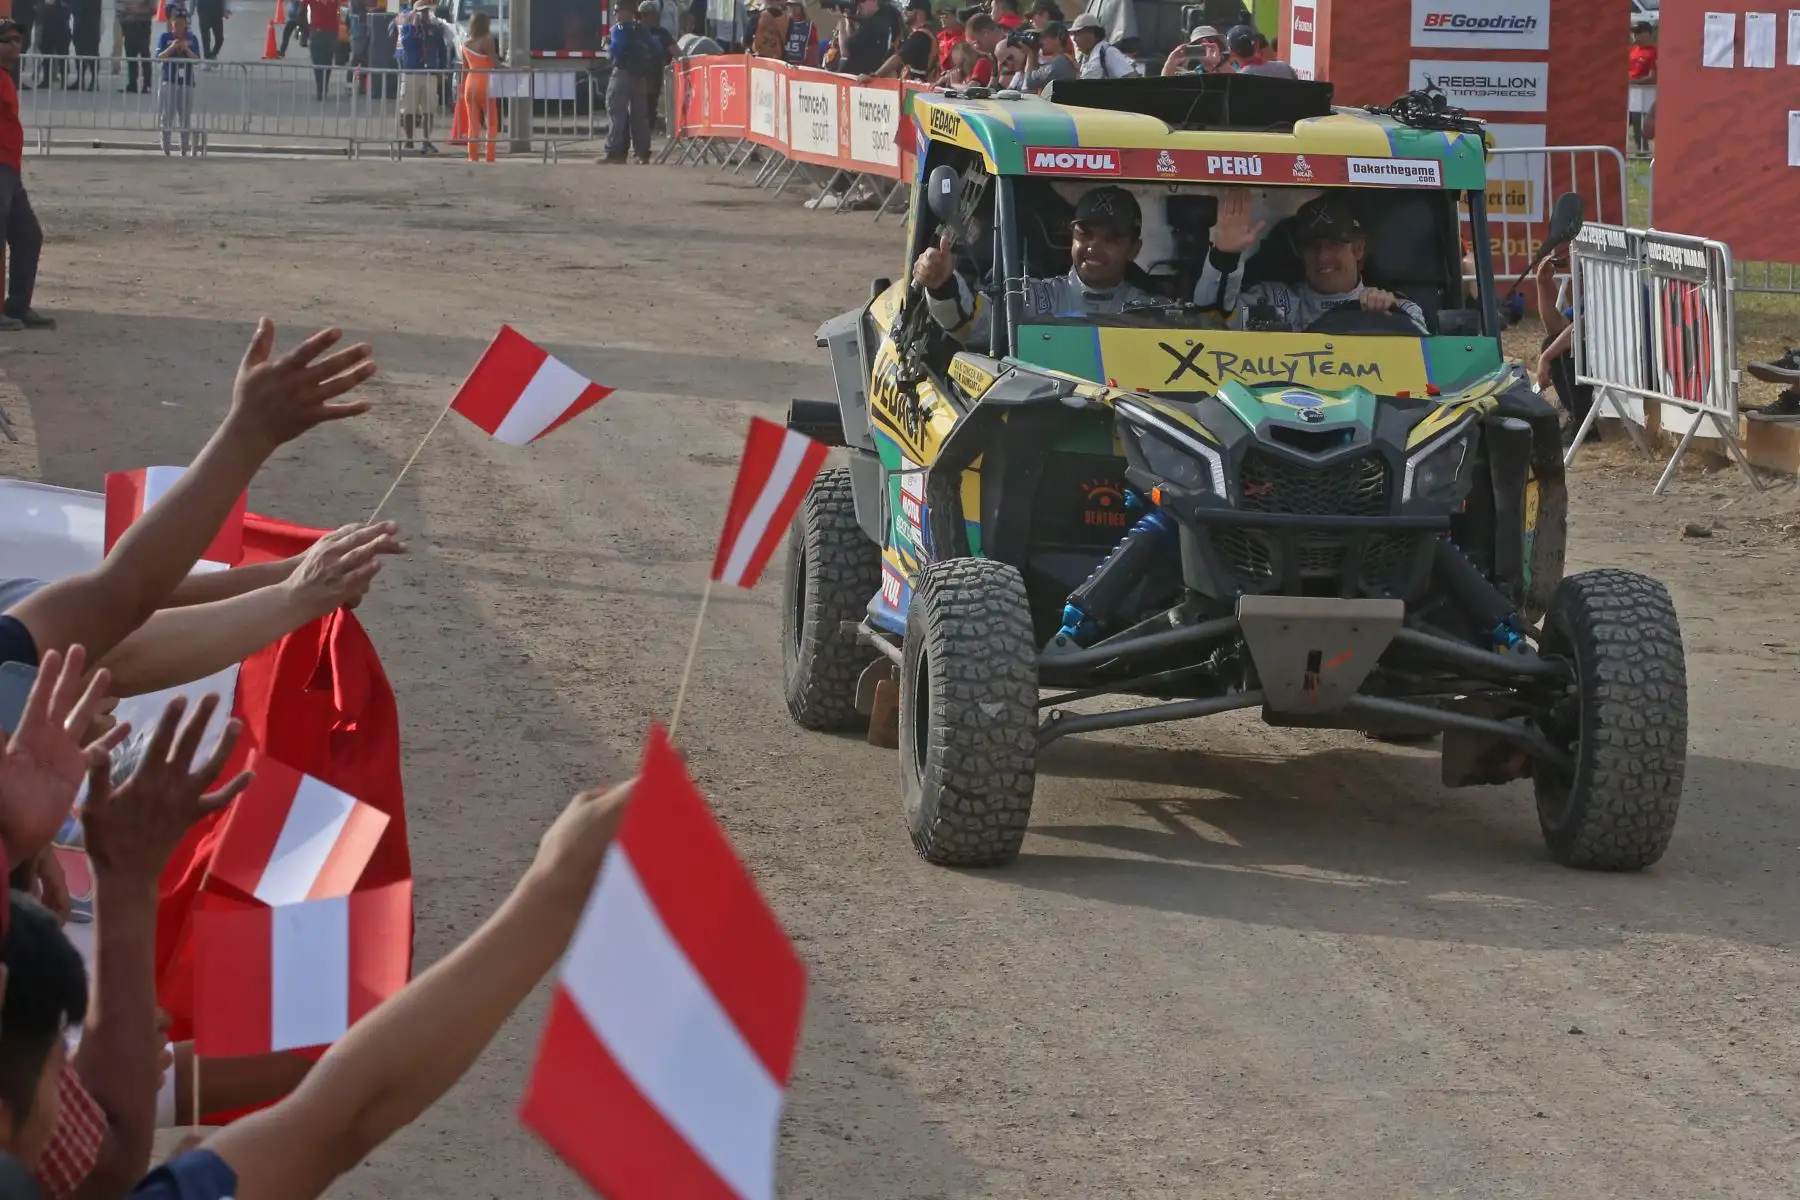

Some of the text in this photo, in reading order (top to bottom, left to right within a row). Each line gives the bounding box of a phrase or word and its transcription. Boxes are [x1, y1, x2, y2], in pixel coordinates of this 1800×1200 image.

[1423, 13, 1538, 29] BFGoodrich
[930, 106, 961, 136] VEDACIT
[812, 120, 829, 148] sport
[872, 129, 891, 160] sport
[1033, 152, 1116, 169] MOTUL
[1207, 154, 1262, 176] PERÚ
[1353, 163, 1435, 177] Dakarthegame
[1416, 175, 1436, 183] .com
[1158, 342, 1218, 386] X
